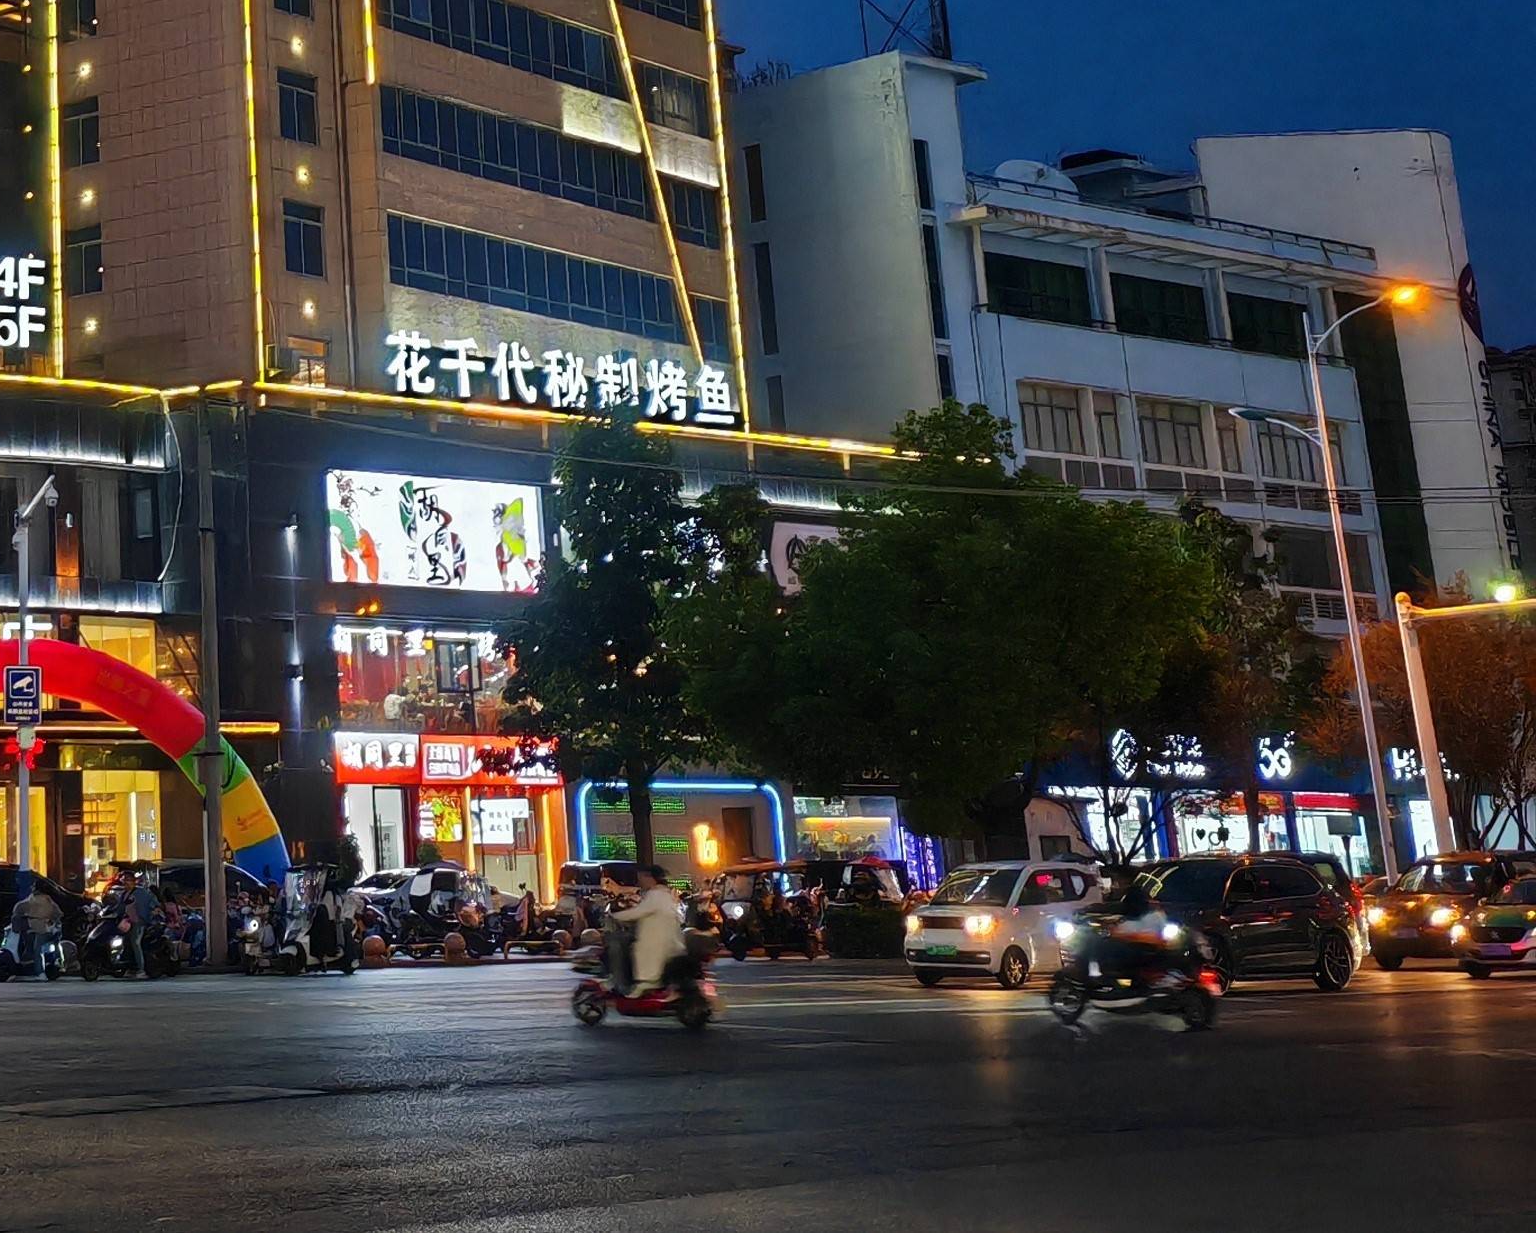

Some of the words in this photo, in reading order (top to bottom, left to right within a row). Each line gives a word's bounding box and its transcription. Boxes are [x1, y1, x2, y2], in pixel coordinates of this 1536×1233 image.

[385, 329, 735, 424] 花千代秘制烤鱼
